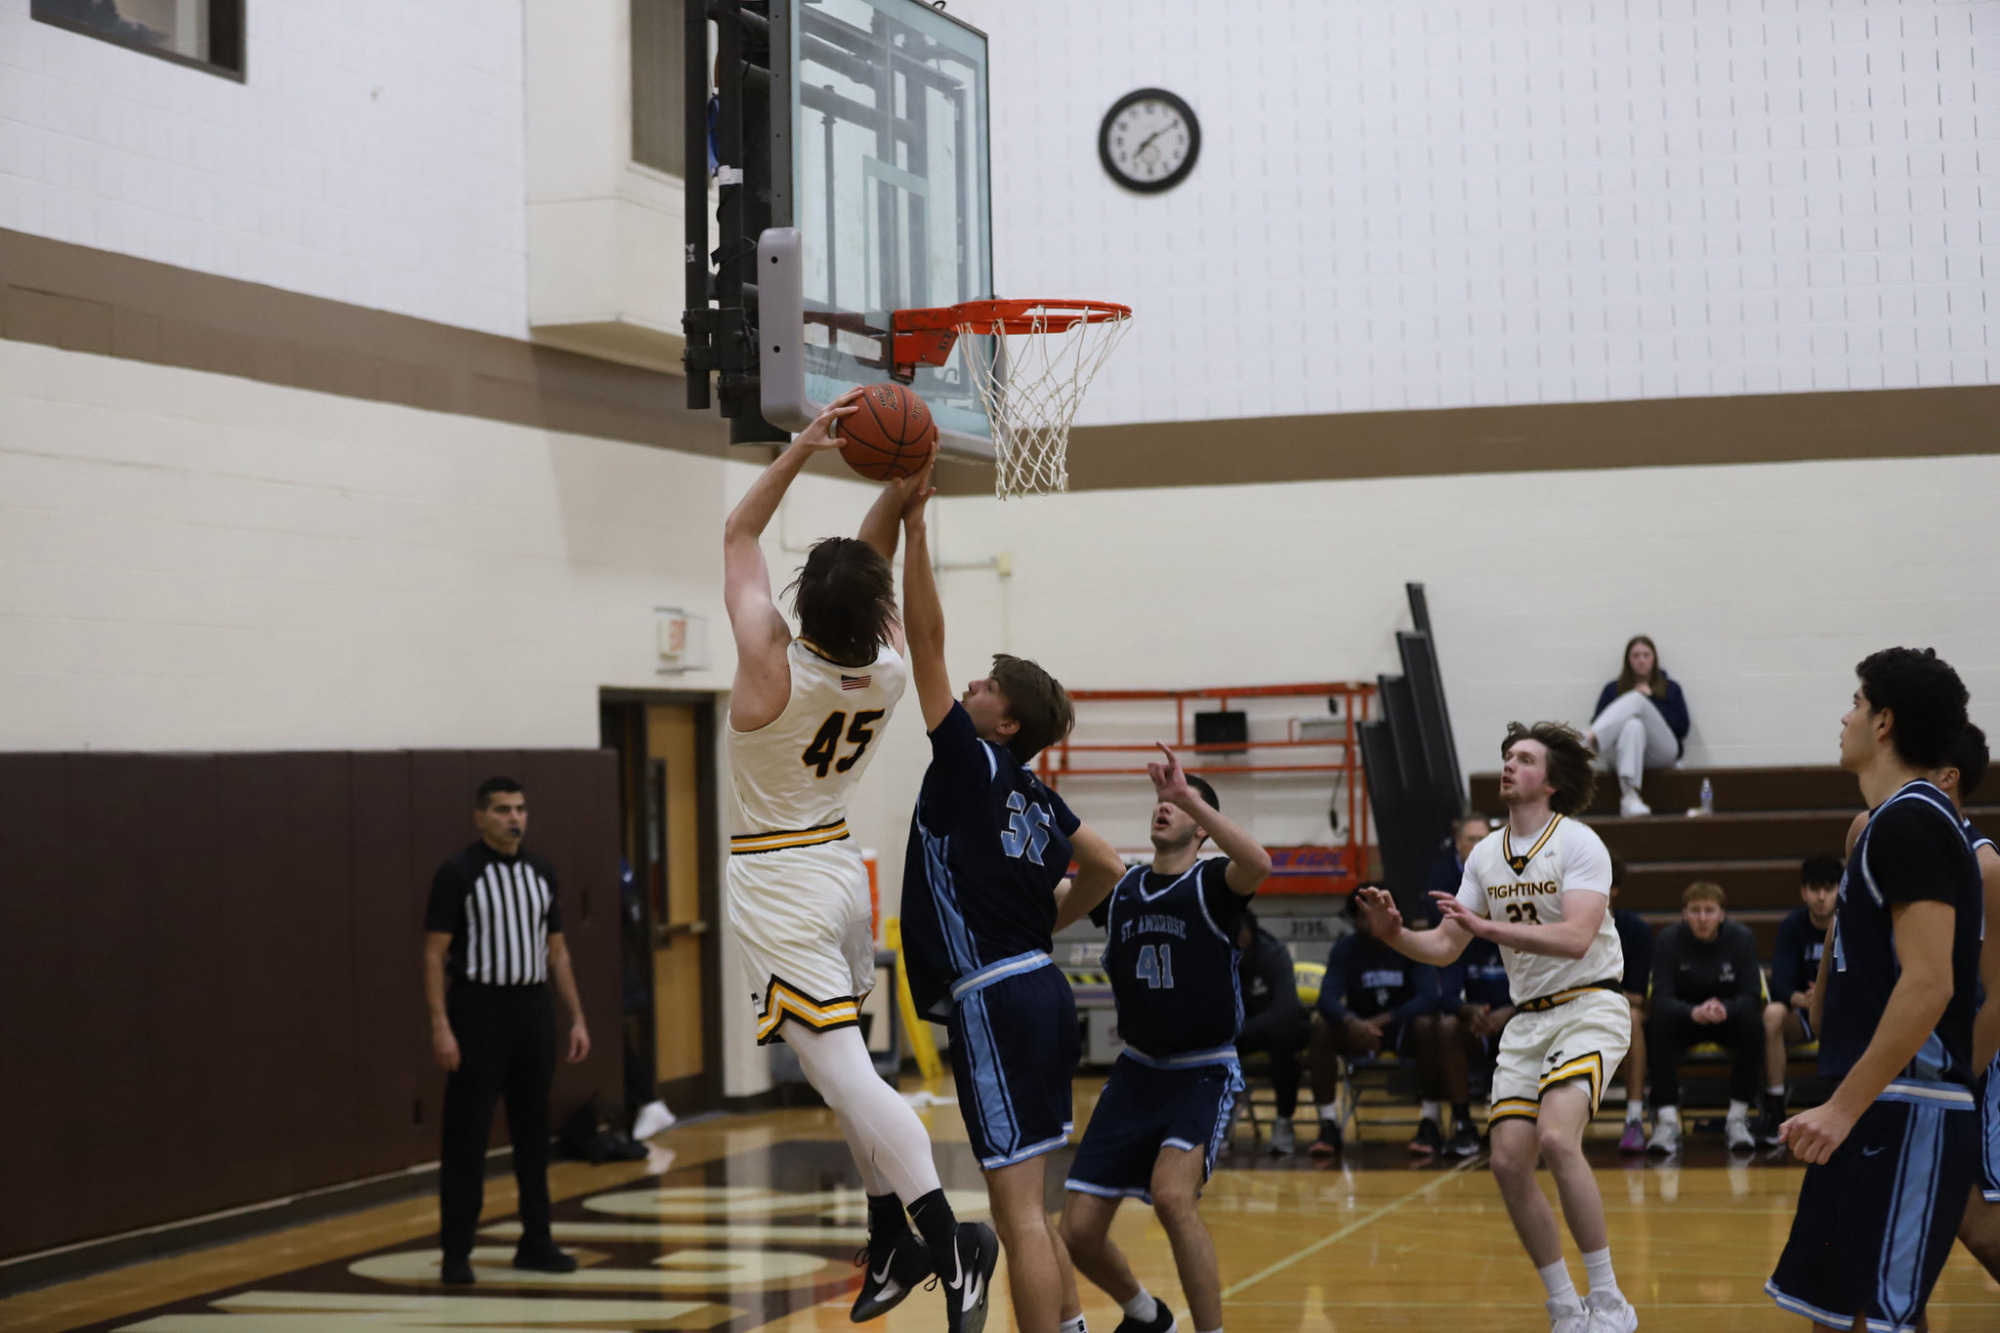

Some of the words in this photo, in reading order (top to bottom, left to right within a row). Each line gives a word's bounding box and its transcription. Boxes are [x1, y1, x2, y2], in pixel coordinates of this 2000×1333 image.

[801, 708, 885, 779] 45
[1487, 881, 1557, 899] FIGHTING
[1121, 919, 1136, 944] ST.
[1138, 914, 1187, 940] AMBROSE
[1136, 944, 1175, 989] 41
